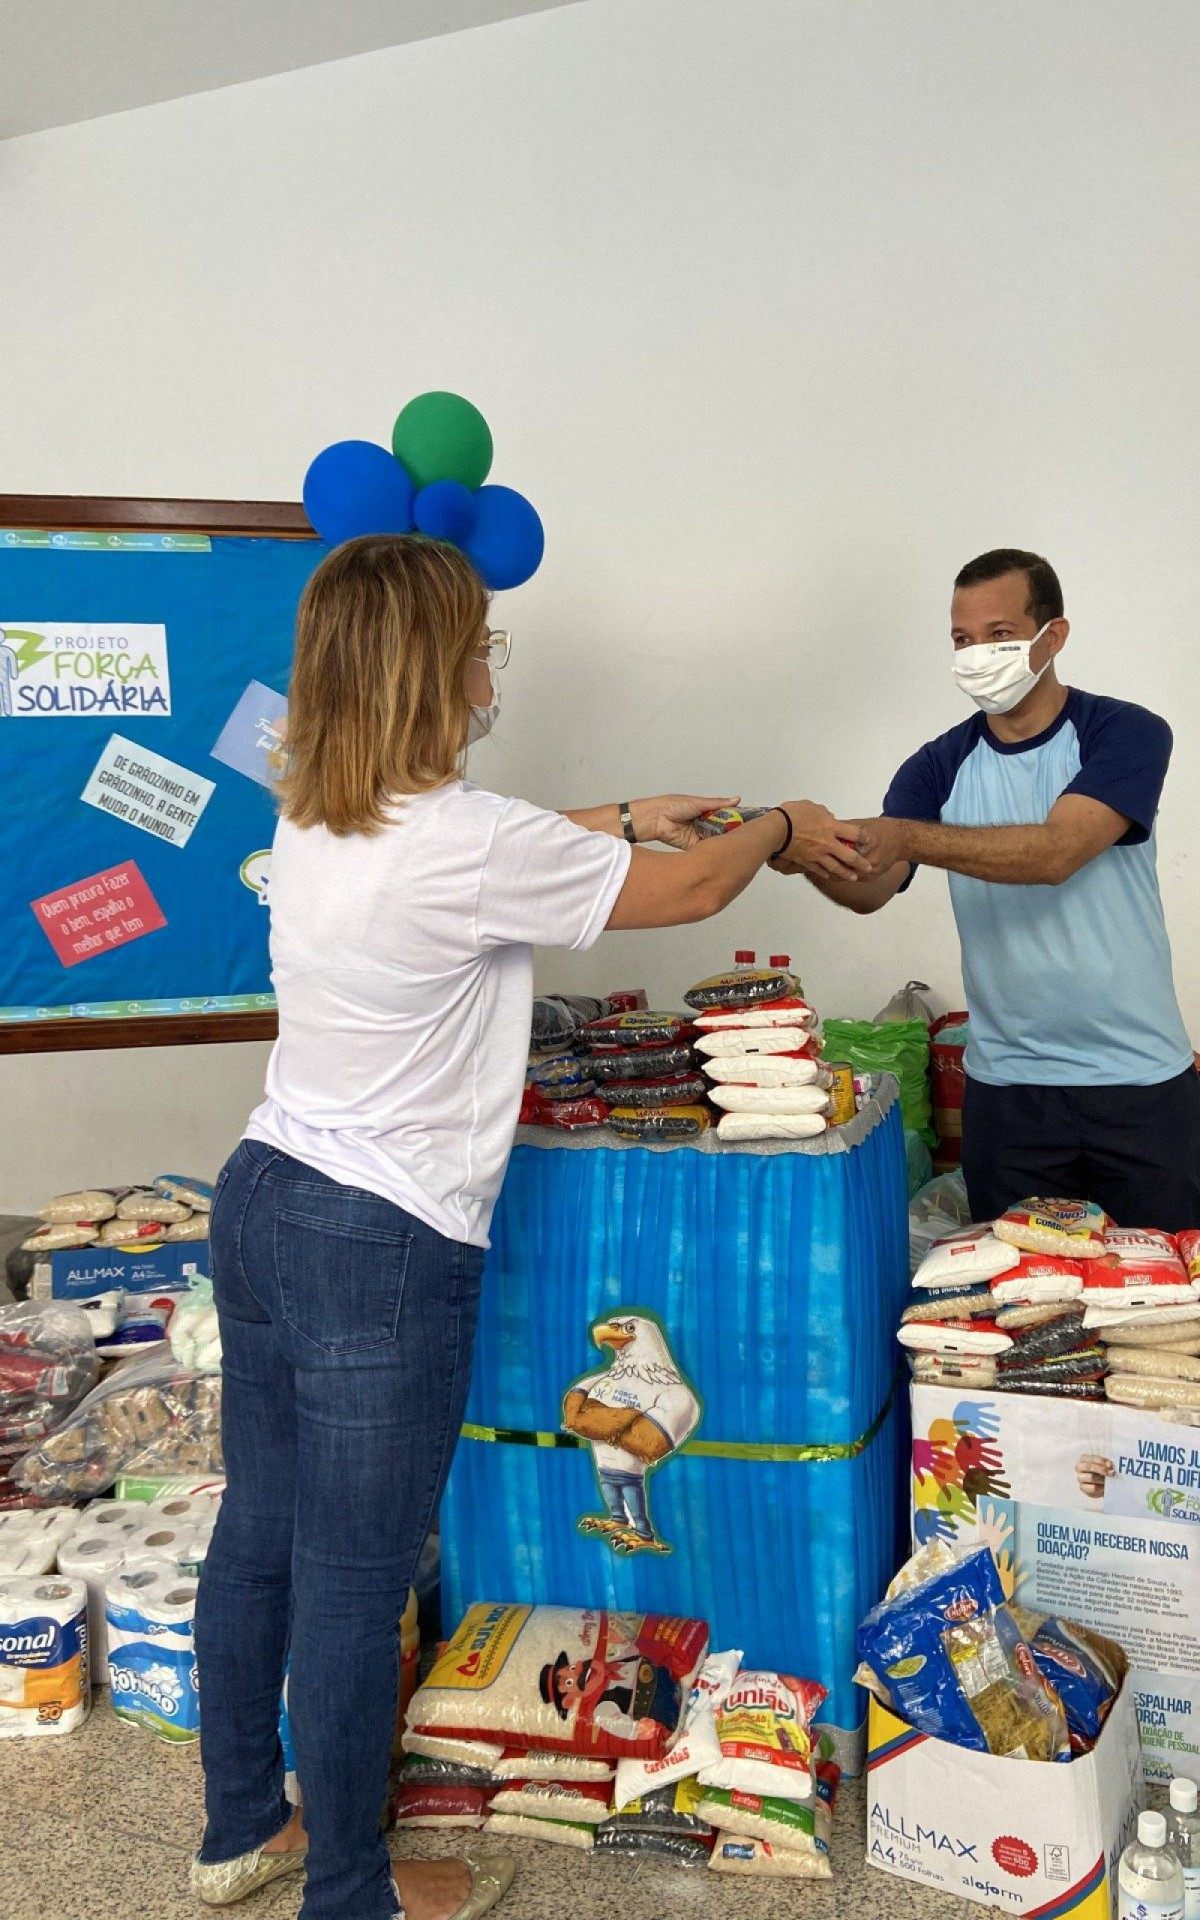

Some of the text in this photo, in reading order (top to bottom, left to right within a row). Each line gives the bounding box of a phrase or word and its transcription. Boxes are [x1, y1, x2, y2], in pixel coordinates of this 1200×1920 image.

[54, 636, 129, 649] PROJETO
[54, 651, 159, 684] FORÇA
[18, 679, 168, 711] SOLIDÁRIA
[113, 755, 200, 806] DE GRÃOZINHO EM
[98, 793, 175, 840] MUDA O MUNDO.
[156, 799, 166, 812] A
[166, 804, 198, 828] GENTE
[41, 900, 70, 918] Quem
[68, 884, 104, 910] procura
[60, 924, 70, 935] o
[93, 898, 127, 922] espalha
[126, 896, 134, 908] o
[73, 918, 144, 955] melhor que tem
[68, 1266, 126, 1280] ALLMAX
[132, 1270, 145, 1279] A4
[1138, 1440, 1186, 1465] VAMOS
[1118, 1456, 1160, 1480] FAZER
[1164, 1466, 1173, 1484] A
[1037, 1522, 1189, 1560] QUEM VAI RECEBER NOSSA
[1037, 1539, 1090, 1560] DOAÇÃO?
[1174, 1731, 1184, 1740] DE
[644, 1746, 690, 1774] Caravelas
[870, 1820, 921, 1854] PREMIUM
[871, 1802, 978, 1863] ALLMAX
[872, 1839, 896, 1864] A4
[962, 1876, 1023, 1902] aloform
